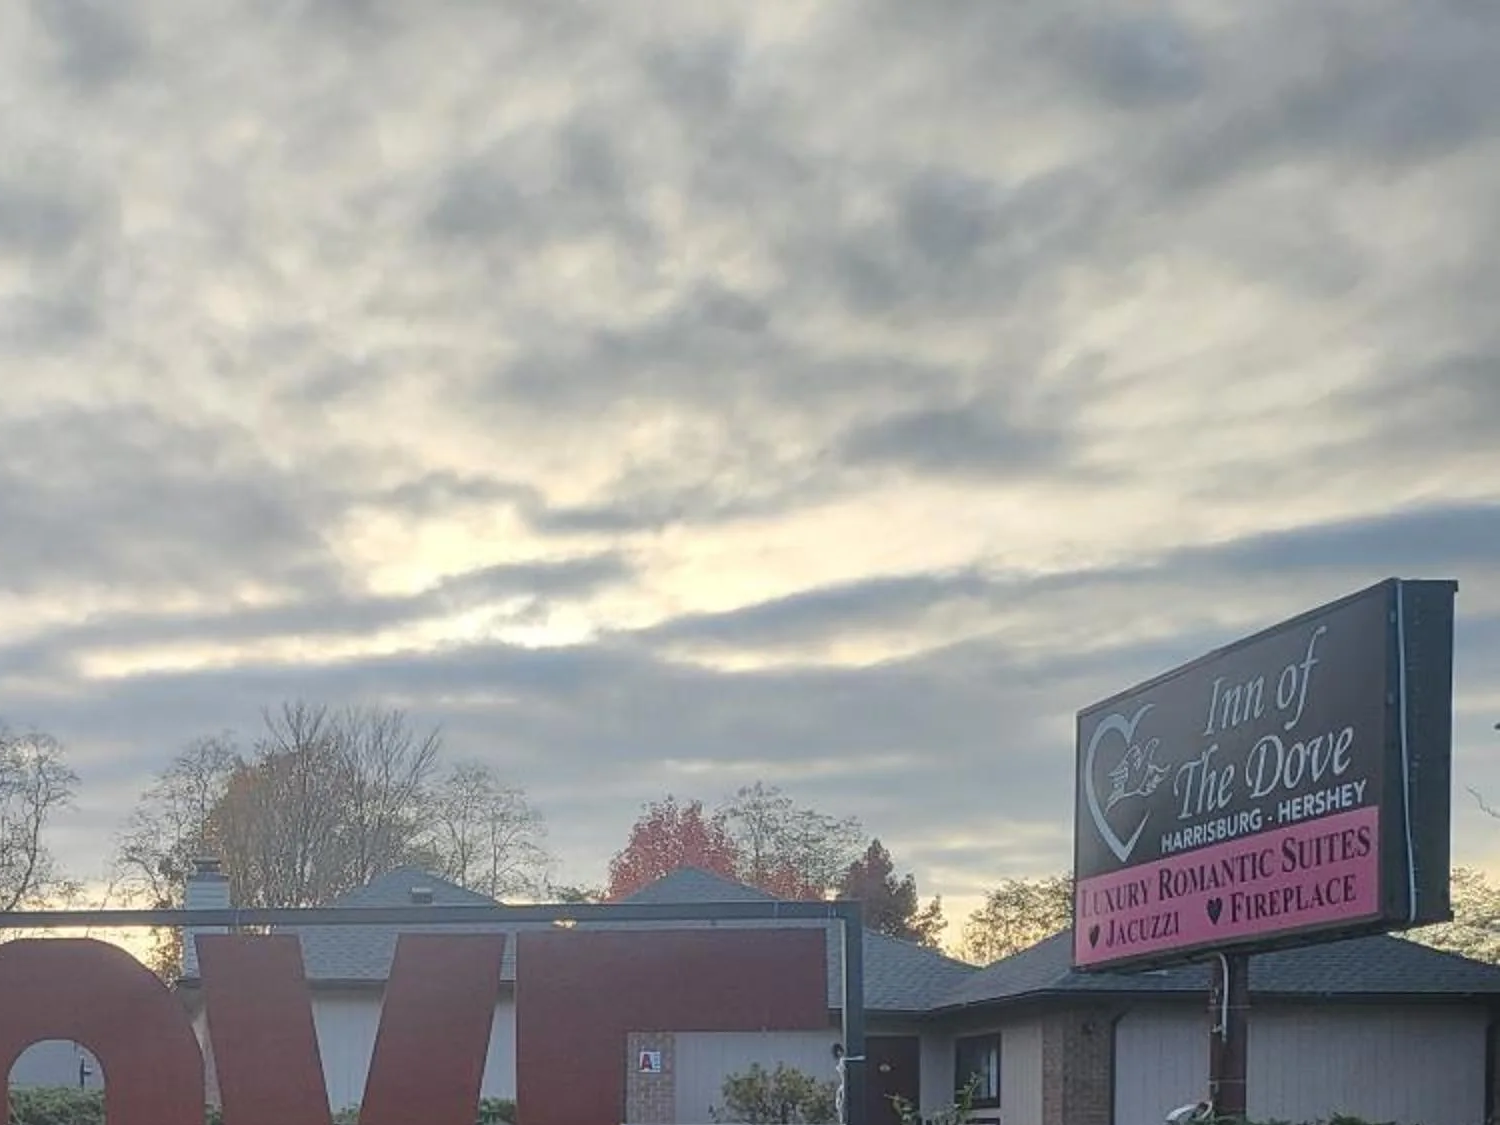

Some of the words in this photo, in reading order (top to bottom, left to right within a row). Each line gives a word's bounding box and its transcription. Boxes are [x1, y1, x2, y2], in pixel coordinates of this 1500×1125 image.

[1203, 675, 1265, 736] Inn
[1276, 625, 1328, 731] of
[1160, 807, 1263, 854] HARRISBURG
[1277, 778, 1368, 824] HERSHEY
[1173, 743, 1236, 820] The
[1245, 726, 1354, 799] Dove
[1080, 878, 1150, 919] LUXURY
[1158, 849, 1275, 901] ROMANTIC
[1281, 825, 1372, 874] SUITES
[1105, 910, 1180, 948] JACUZZI
[1229, 874, 1357, 924] FIREPLACE
